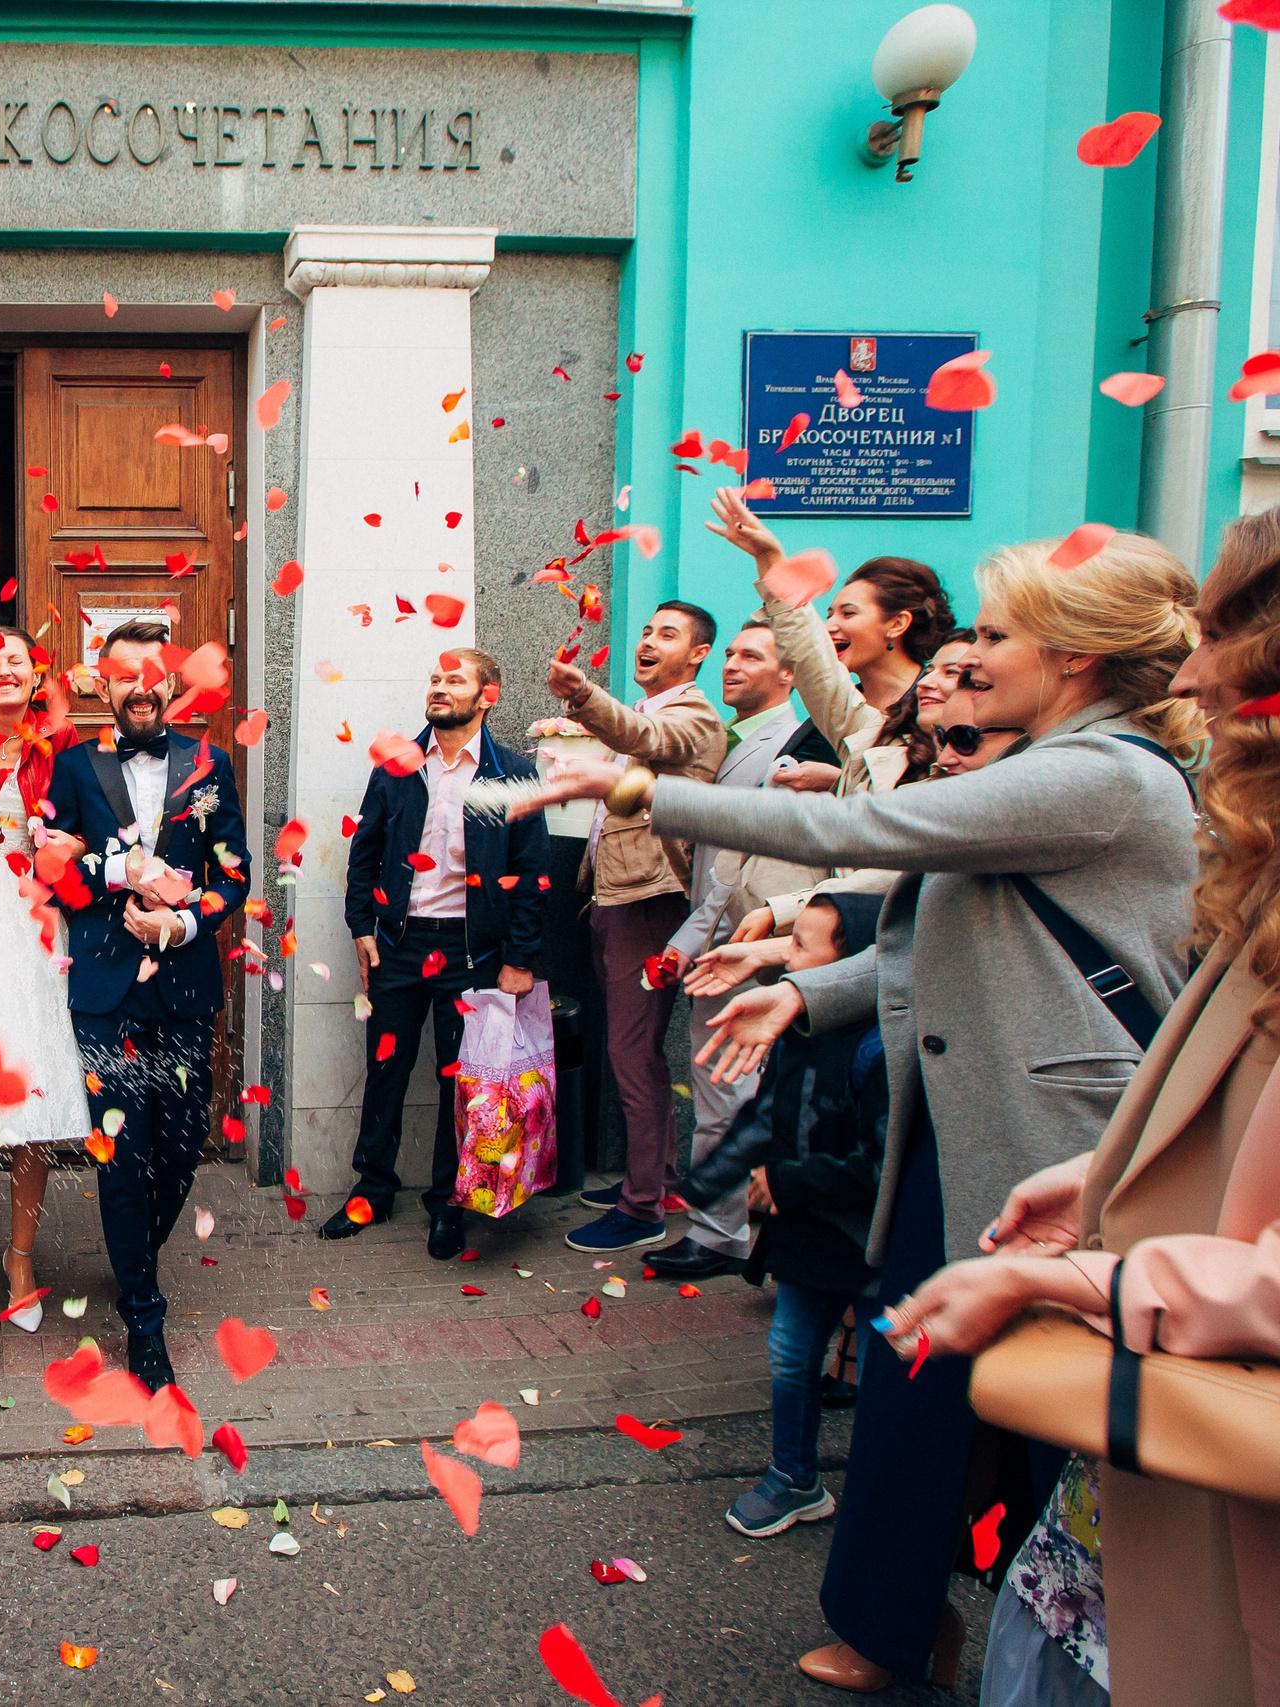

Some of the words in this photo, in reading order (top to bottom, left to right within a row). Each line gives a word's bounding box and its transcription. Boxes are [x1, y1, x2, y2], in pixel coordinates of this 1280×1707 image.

[818, 404, 905, 425] ДВОРЕЦ
[758, 429, 935, 445] БРКОСОЧЕТАНИЯ
[822, 449, 851, 457] ЧАСЫ
[773, 486, 805, 494] ЕРВЫЙ
[811, 487, 854, 495] ВТОРНИК
[861, 487, 907, 495] КАЖДОГО
[801, 495, 877, 505] САНИТАРНЫЙ
[882, 496, 915, 506] ДЕНЬ
